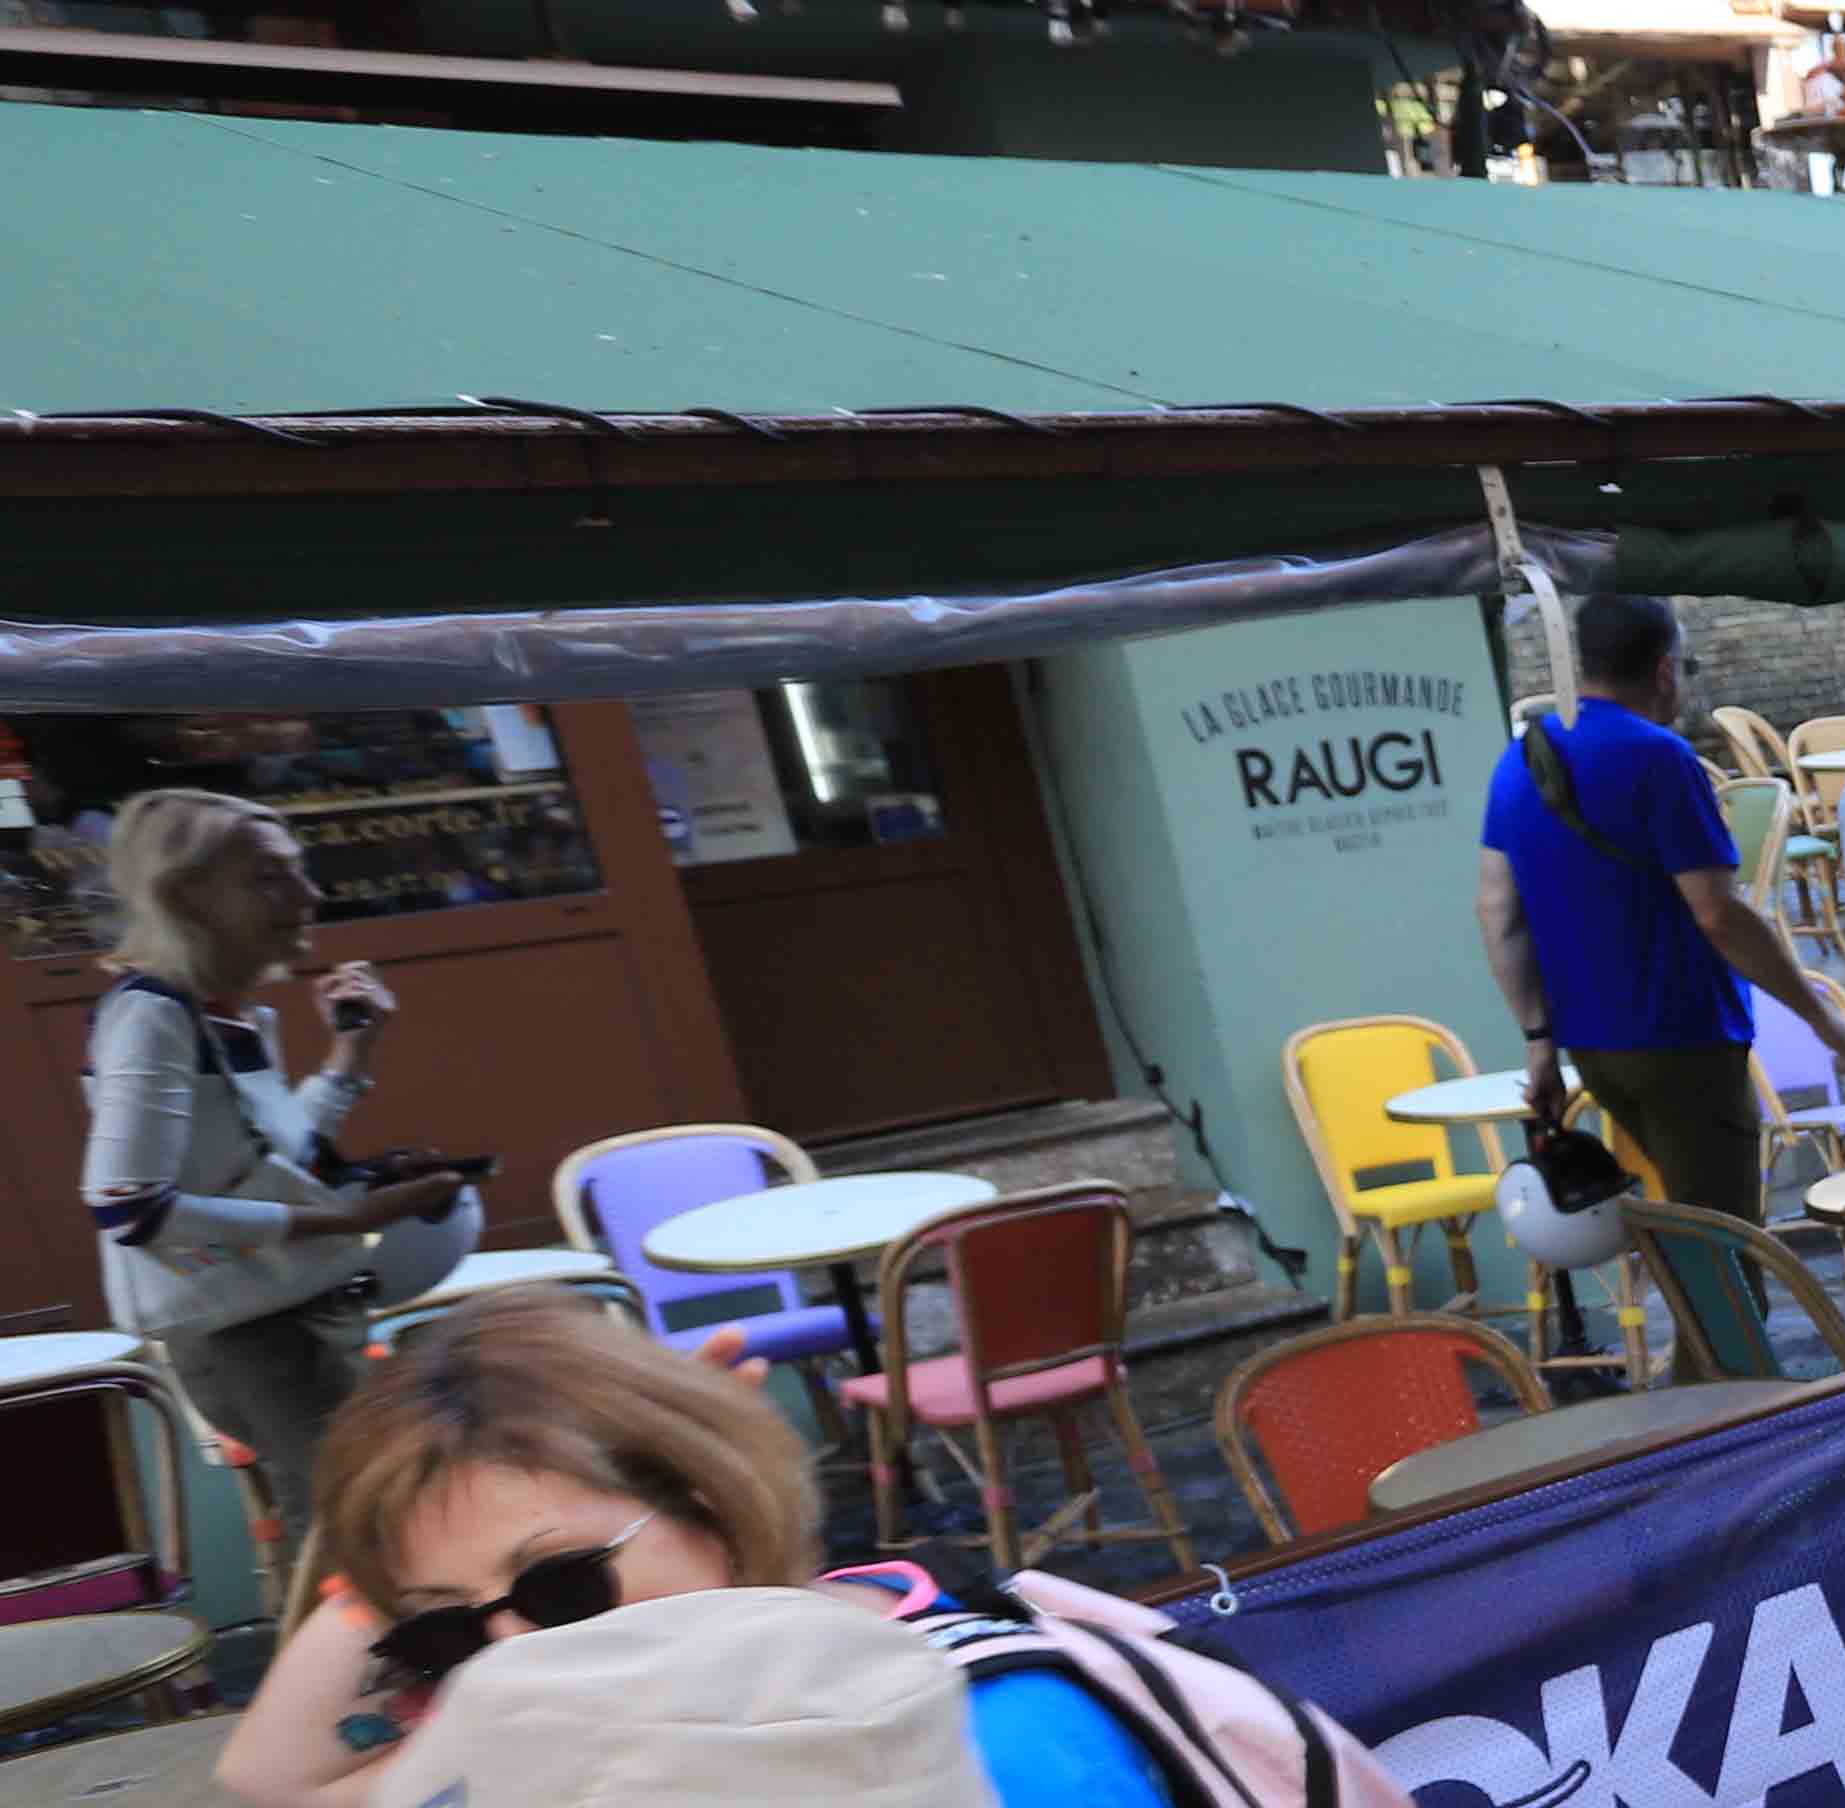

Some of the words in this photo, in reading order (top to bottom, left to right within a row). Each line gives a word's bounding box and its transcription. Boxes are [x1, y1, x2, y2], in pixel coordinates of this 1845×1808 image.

[1181, 701, 1224, 744] LA
[1221, 675, 1306, 729] GLACE
[1311, 671, 1465, 717] GOURMANDE
[1235, 727, 1444, 809] RAUGI
